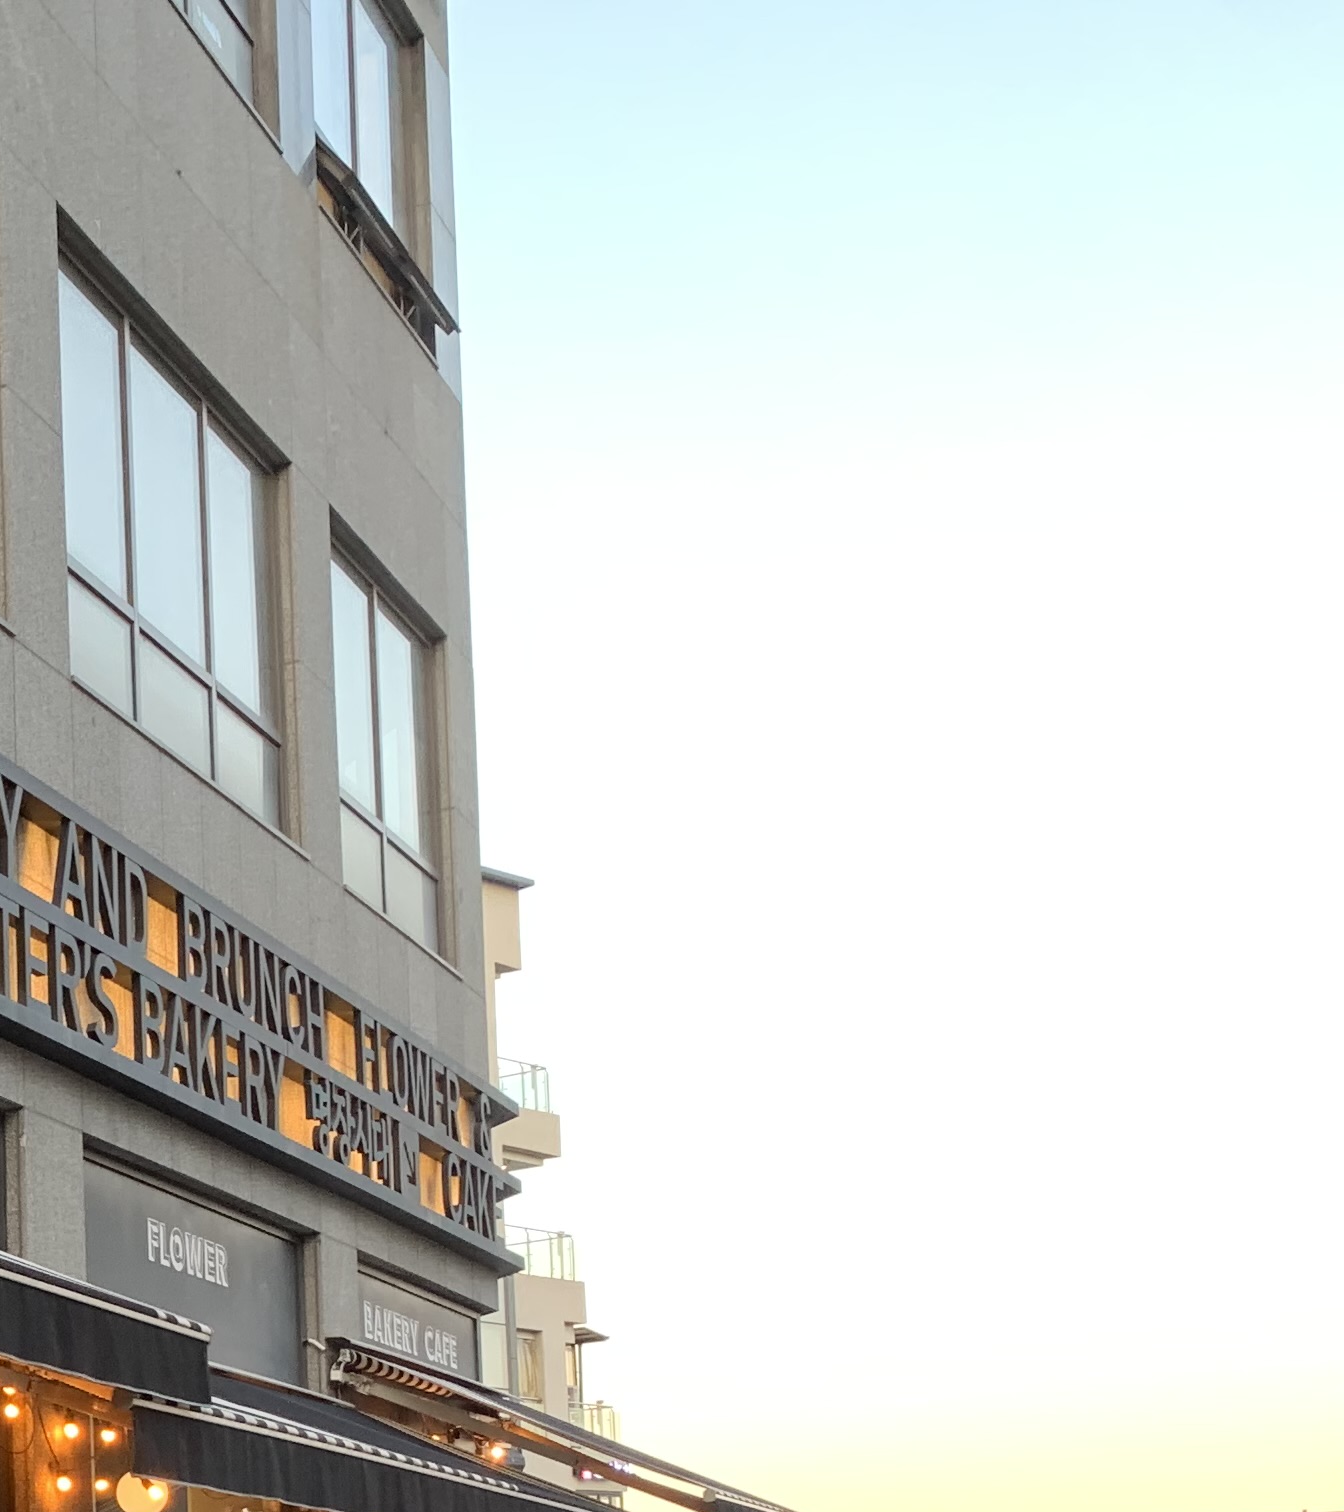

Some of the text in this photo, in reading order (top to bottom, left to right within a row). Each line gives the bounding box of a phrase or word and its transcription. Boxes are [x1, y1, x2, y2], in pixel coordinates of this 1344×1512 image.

[53, 816, 149, 963] AND
[178, 891, 327, 1062] BRUNCH
[354, 1008, 462, 1143] FLOWER
[473, 1092, 492, 1161] &
[134, 973, 288, 1131] BAKERY
[310, 1074, 394, 1193] 명장시대
[146, 1216, 229, 1288] FLOWER
[363, 1300, 459, 1370] BAKERY CAFE
